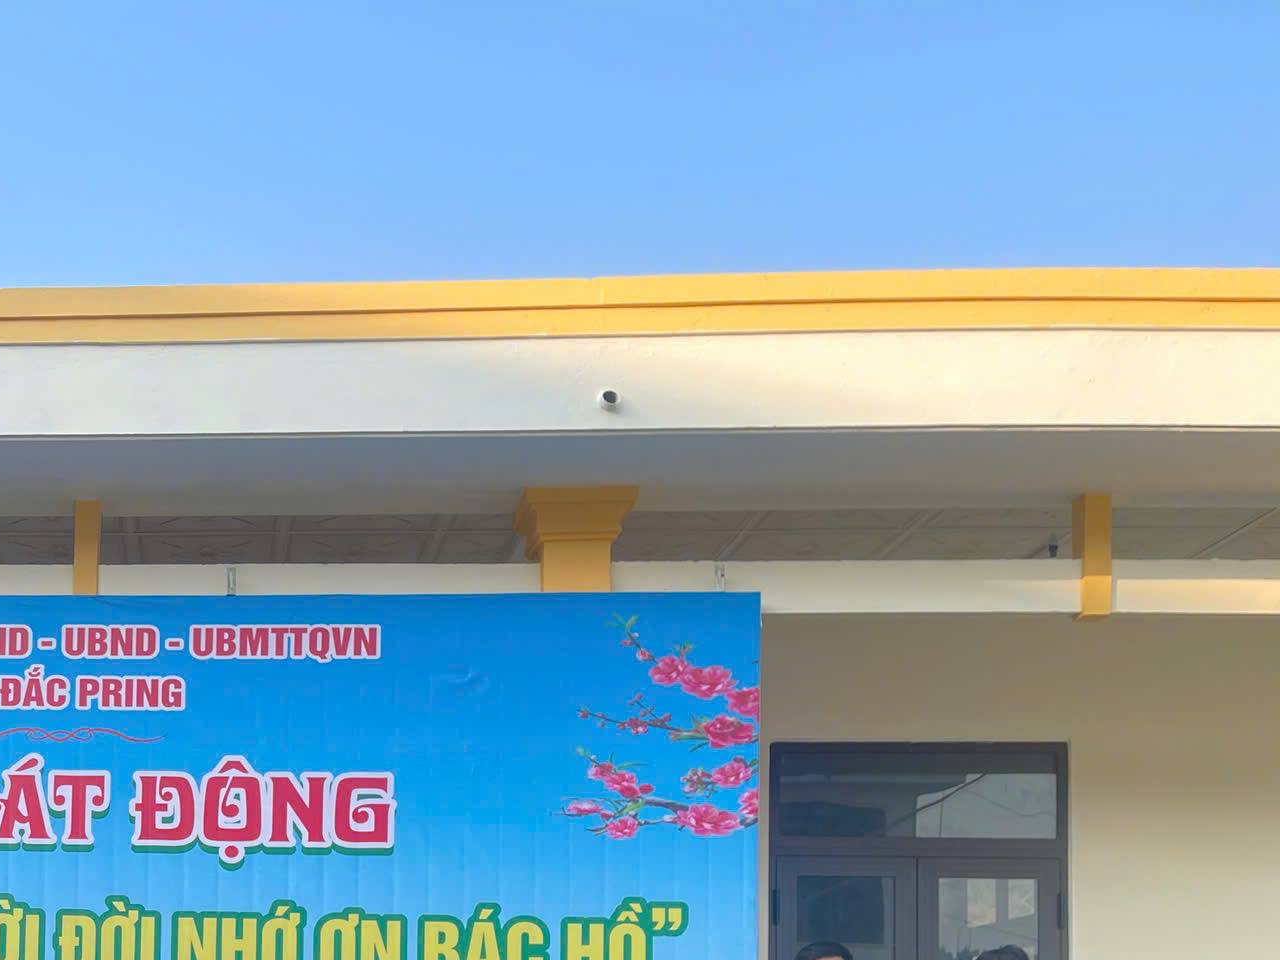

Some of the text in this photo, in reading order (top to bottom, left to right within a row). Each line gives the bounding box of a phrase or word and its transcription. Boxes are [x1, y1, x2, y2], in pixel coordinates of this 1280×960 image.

[63, 626, 157, 658] UBND
[191, 626, 378, 659] UBMTTQVN
[77, 677, 183, 709] PRING
[132, 757, 392, 860] ĐỘNG
